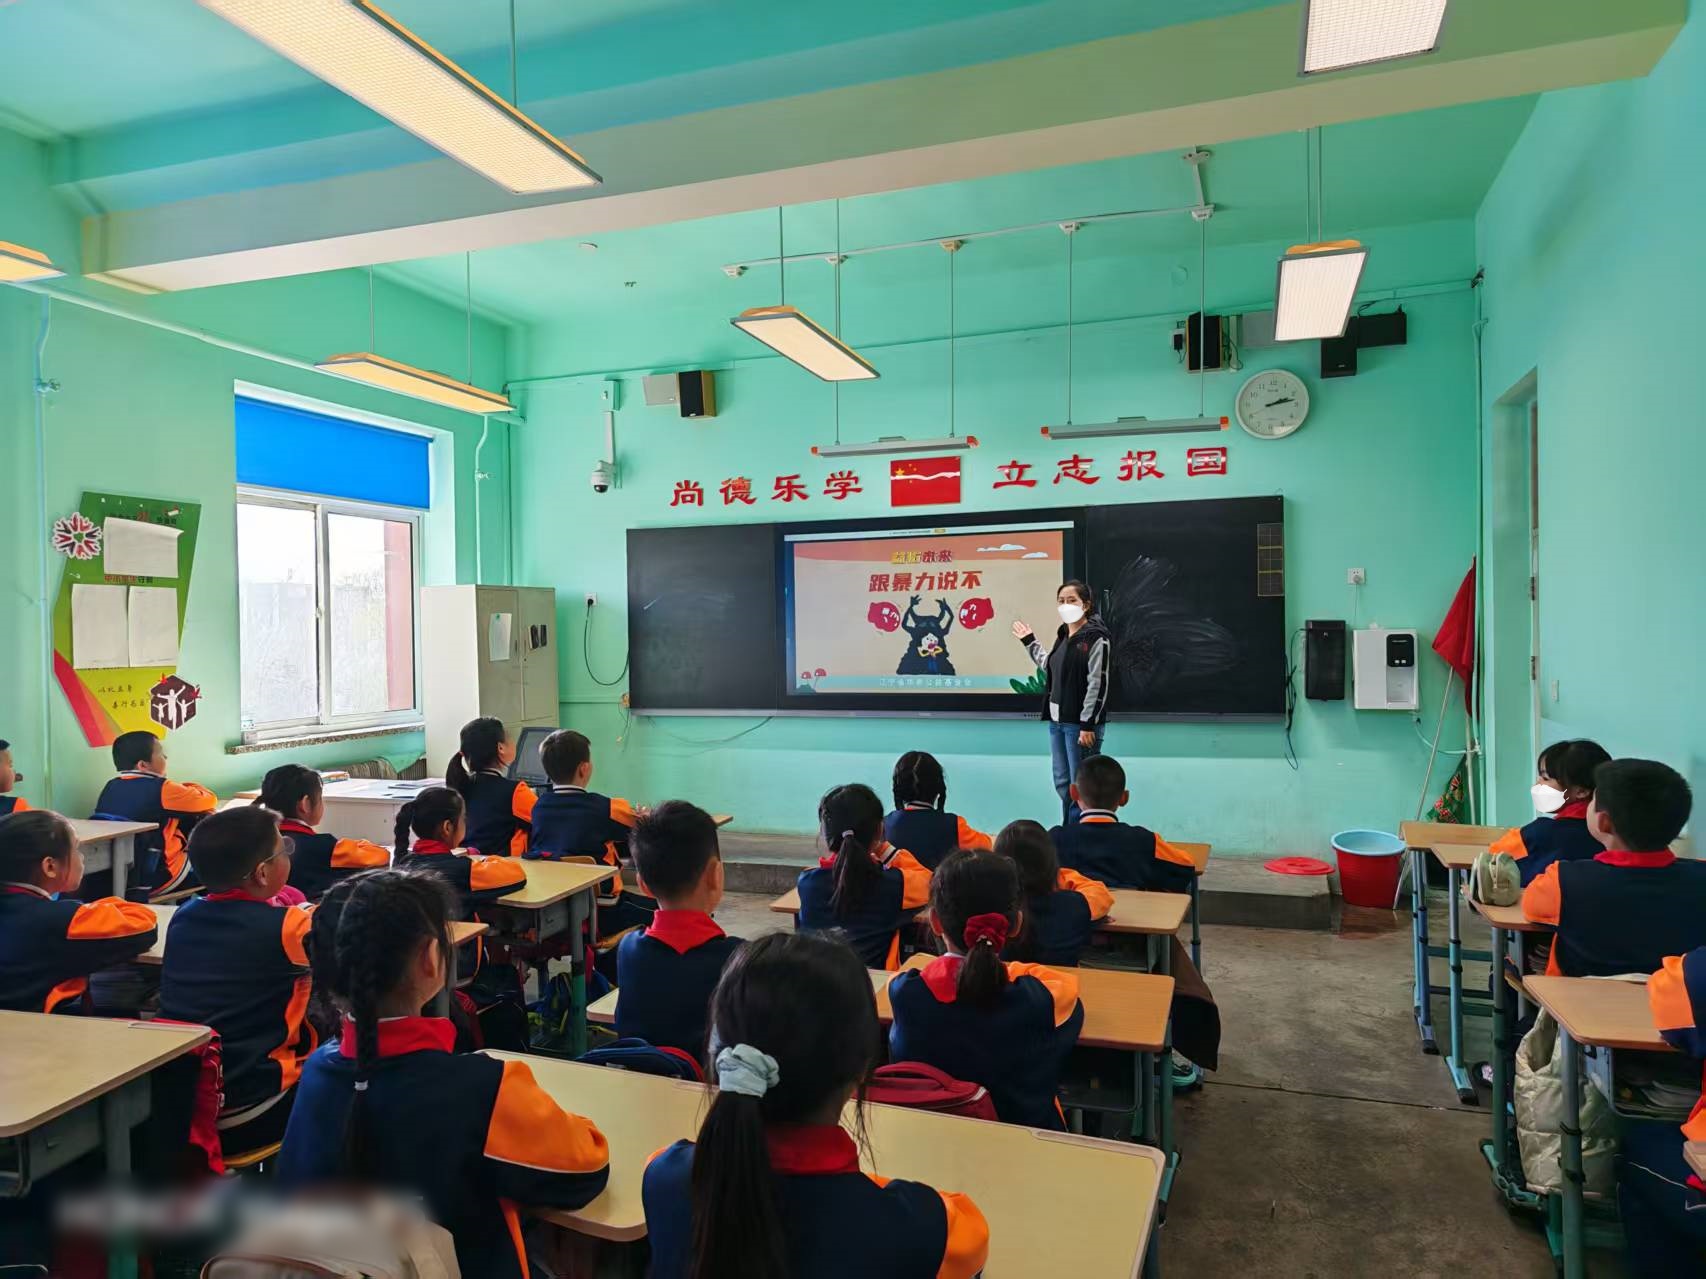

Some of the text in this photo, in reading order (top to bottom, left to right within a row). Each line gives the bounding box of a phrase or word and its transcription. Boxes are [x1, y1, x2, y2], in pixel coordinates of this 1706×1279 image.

[992, 446, 1229, 488] 立志报国
[669, 469, 864, 508] 尚德乐学
[868, 570, 983, 592] 跟暴力说不
